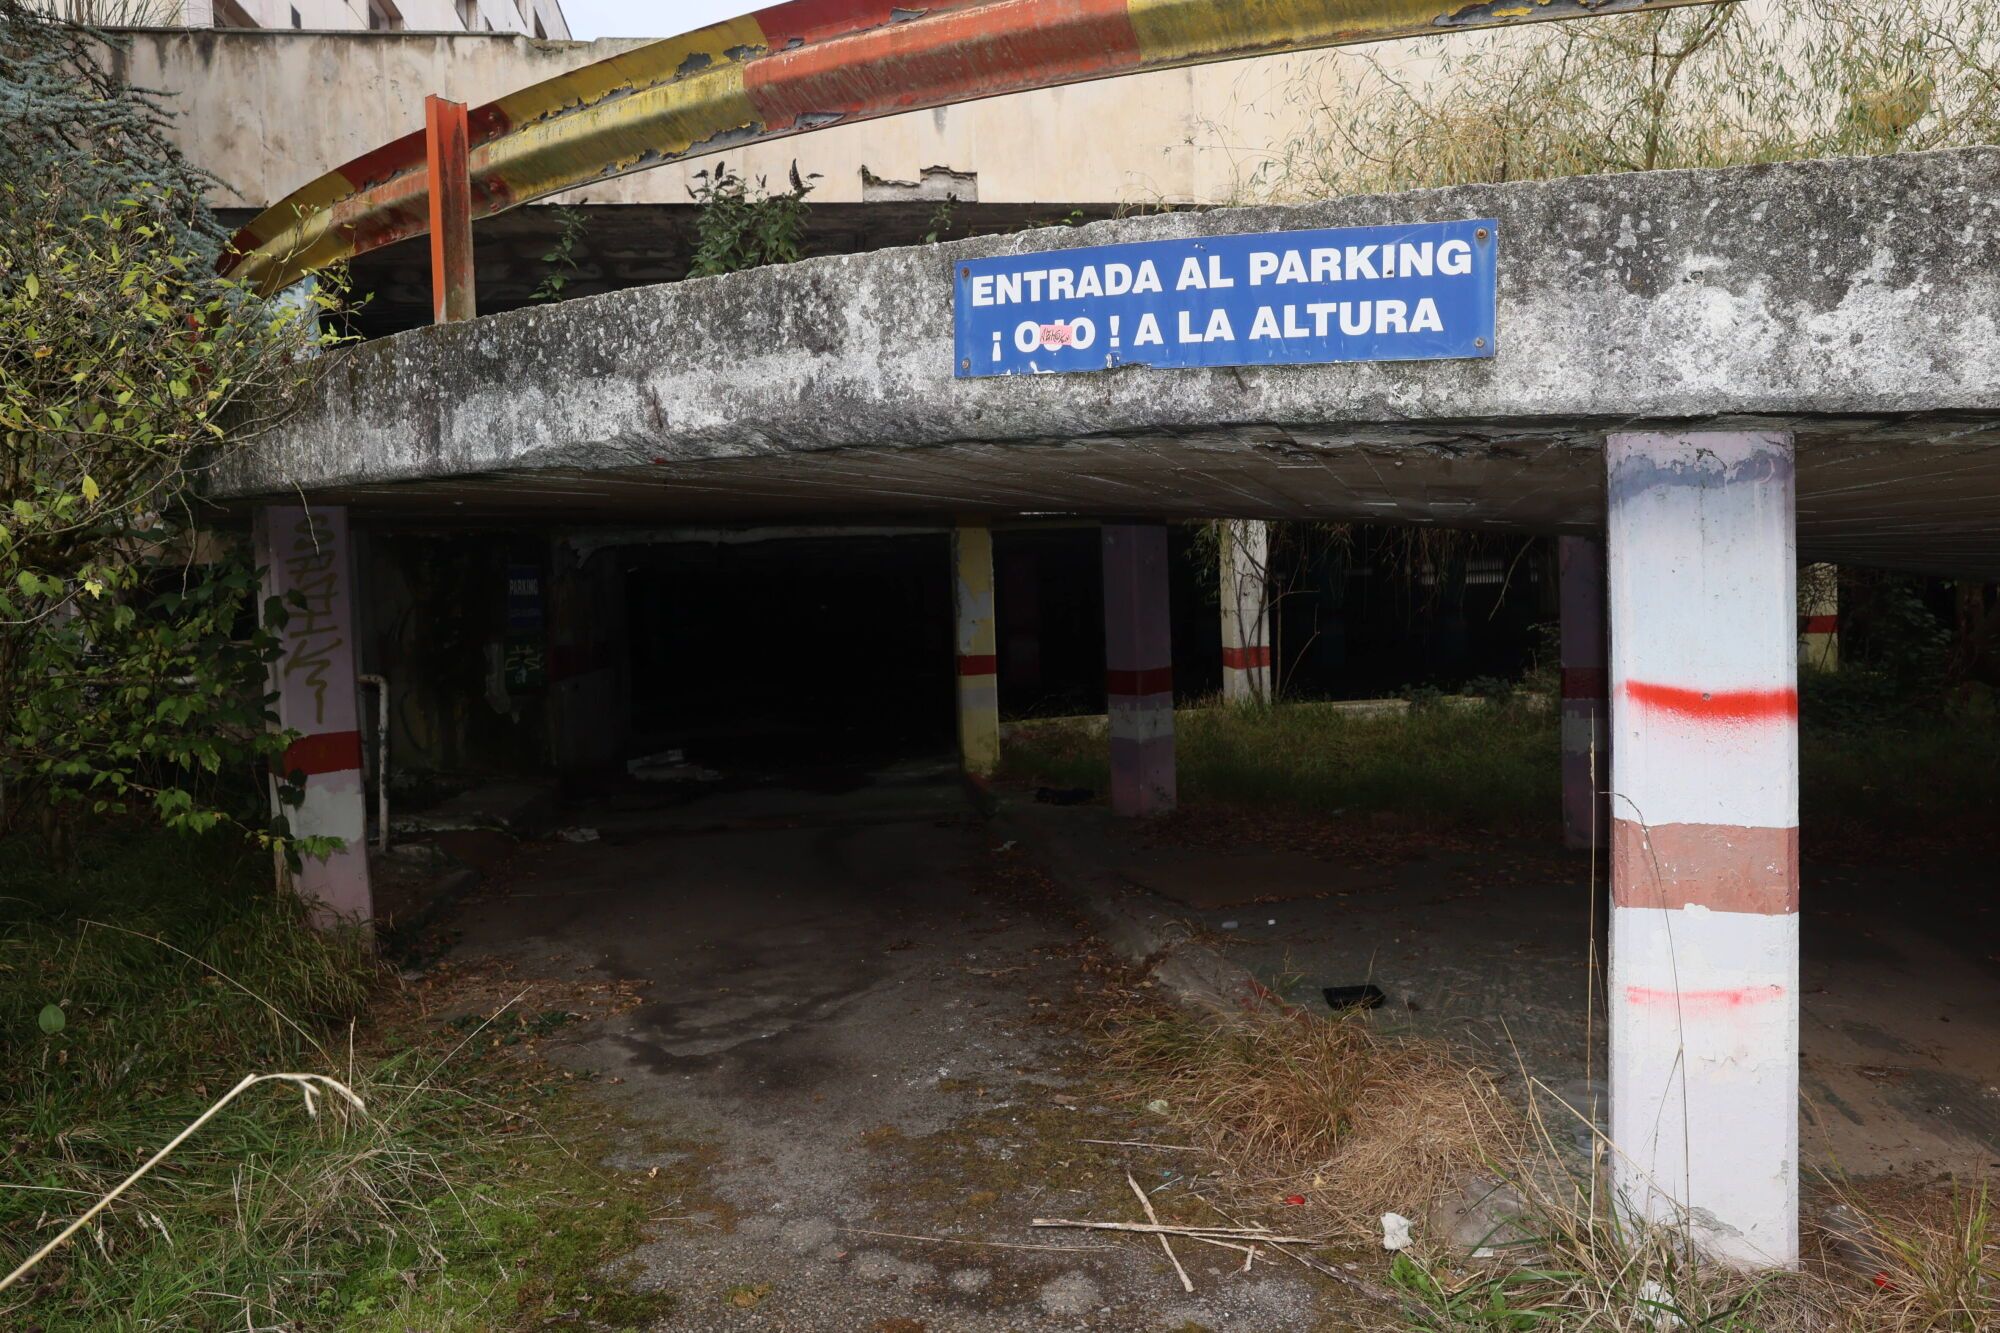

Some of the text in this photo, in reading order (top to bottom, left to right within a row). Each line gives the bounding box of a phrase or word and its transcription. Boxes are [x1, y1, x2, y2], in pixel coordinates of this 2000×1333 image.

[972, 240, 1471, 307] ENTRADA AL PARKING
[1133, 313, 1164, 346] A
[1178, 308, 1235, 343] LA
[1249, 298, 1444, 340] ALTURA
[509, 578, 539, 596] PARKING
